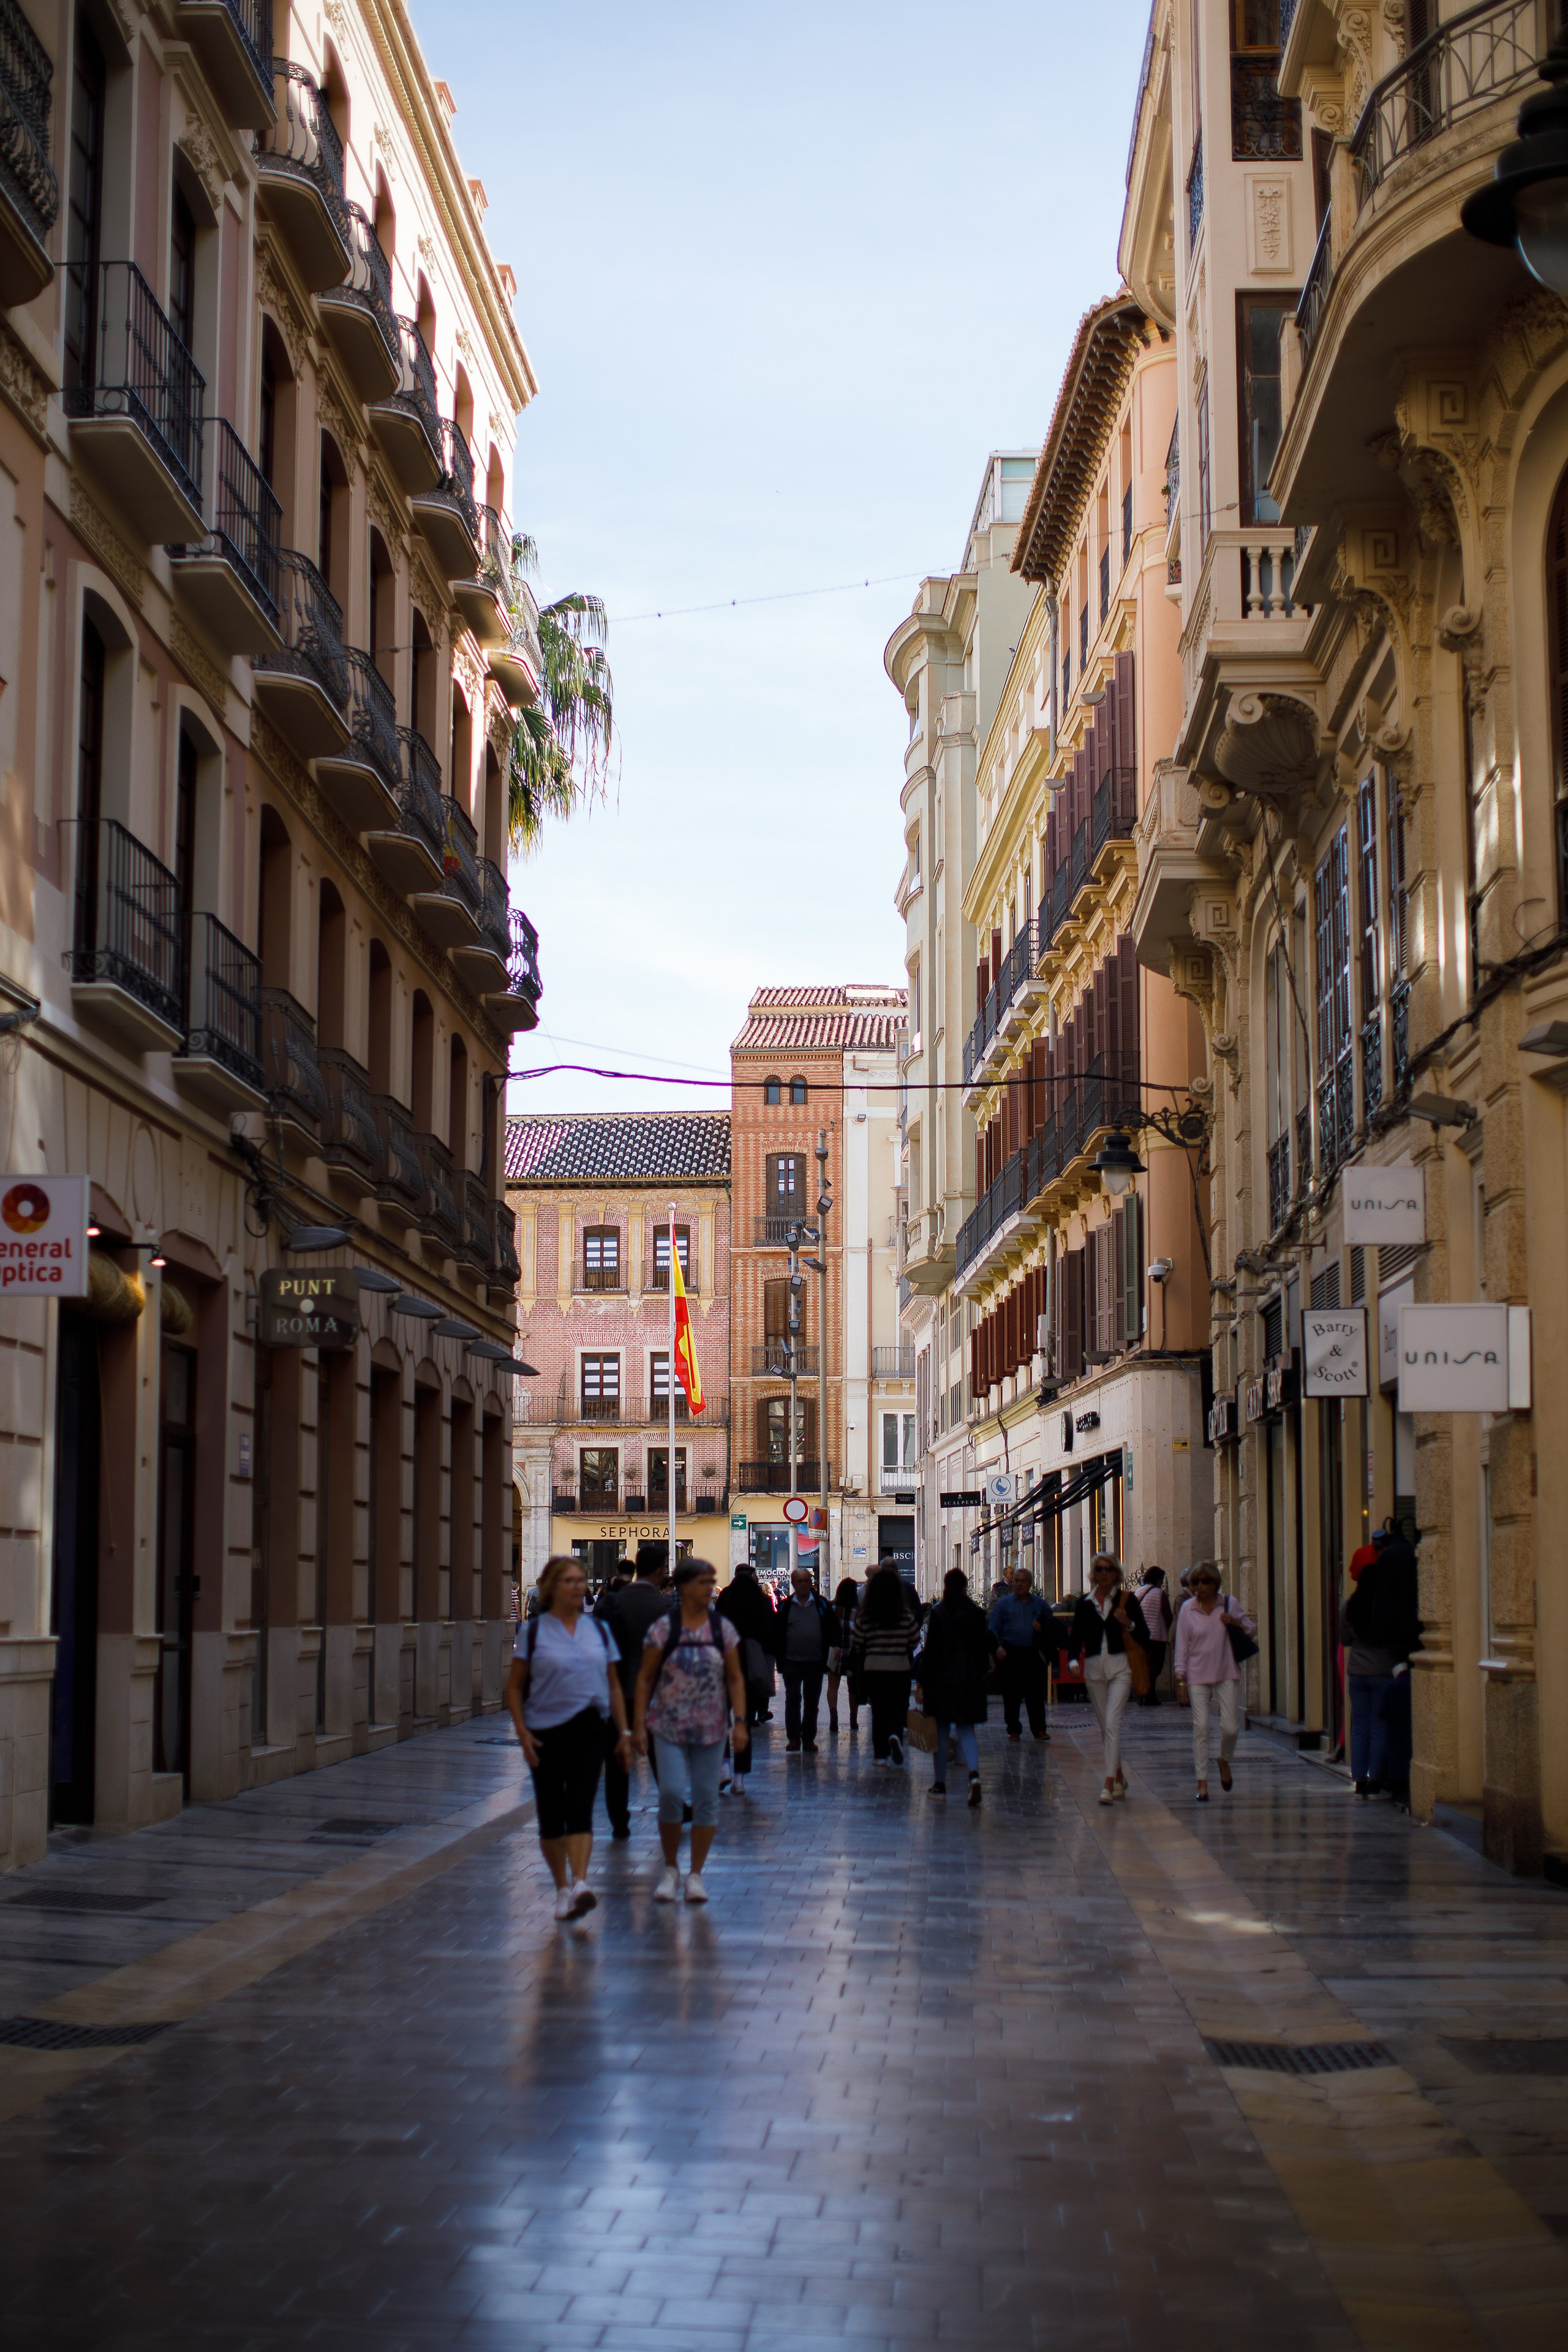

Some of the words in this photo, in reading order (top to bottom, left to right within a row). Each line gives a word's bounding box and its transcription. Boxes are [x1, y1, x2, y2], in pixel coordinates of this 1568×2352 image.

[0, 1261, 62, 1287] ptica
[279, 1279, 336, 1295] PUNT
[276, 1317, 338, 1333] ROMA
[1312, 1323, 1358, 1337] Barry
[1330, 1344, 1343, 1357] &
[600, 1526, 669, 1538] SEPHORA
